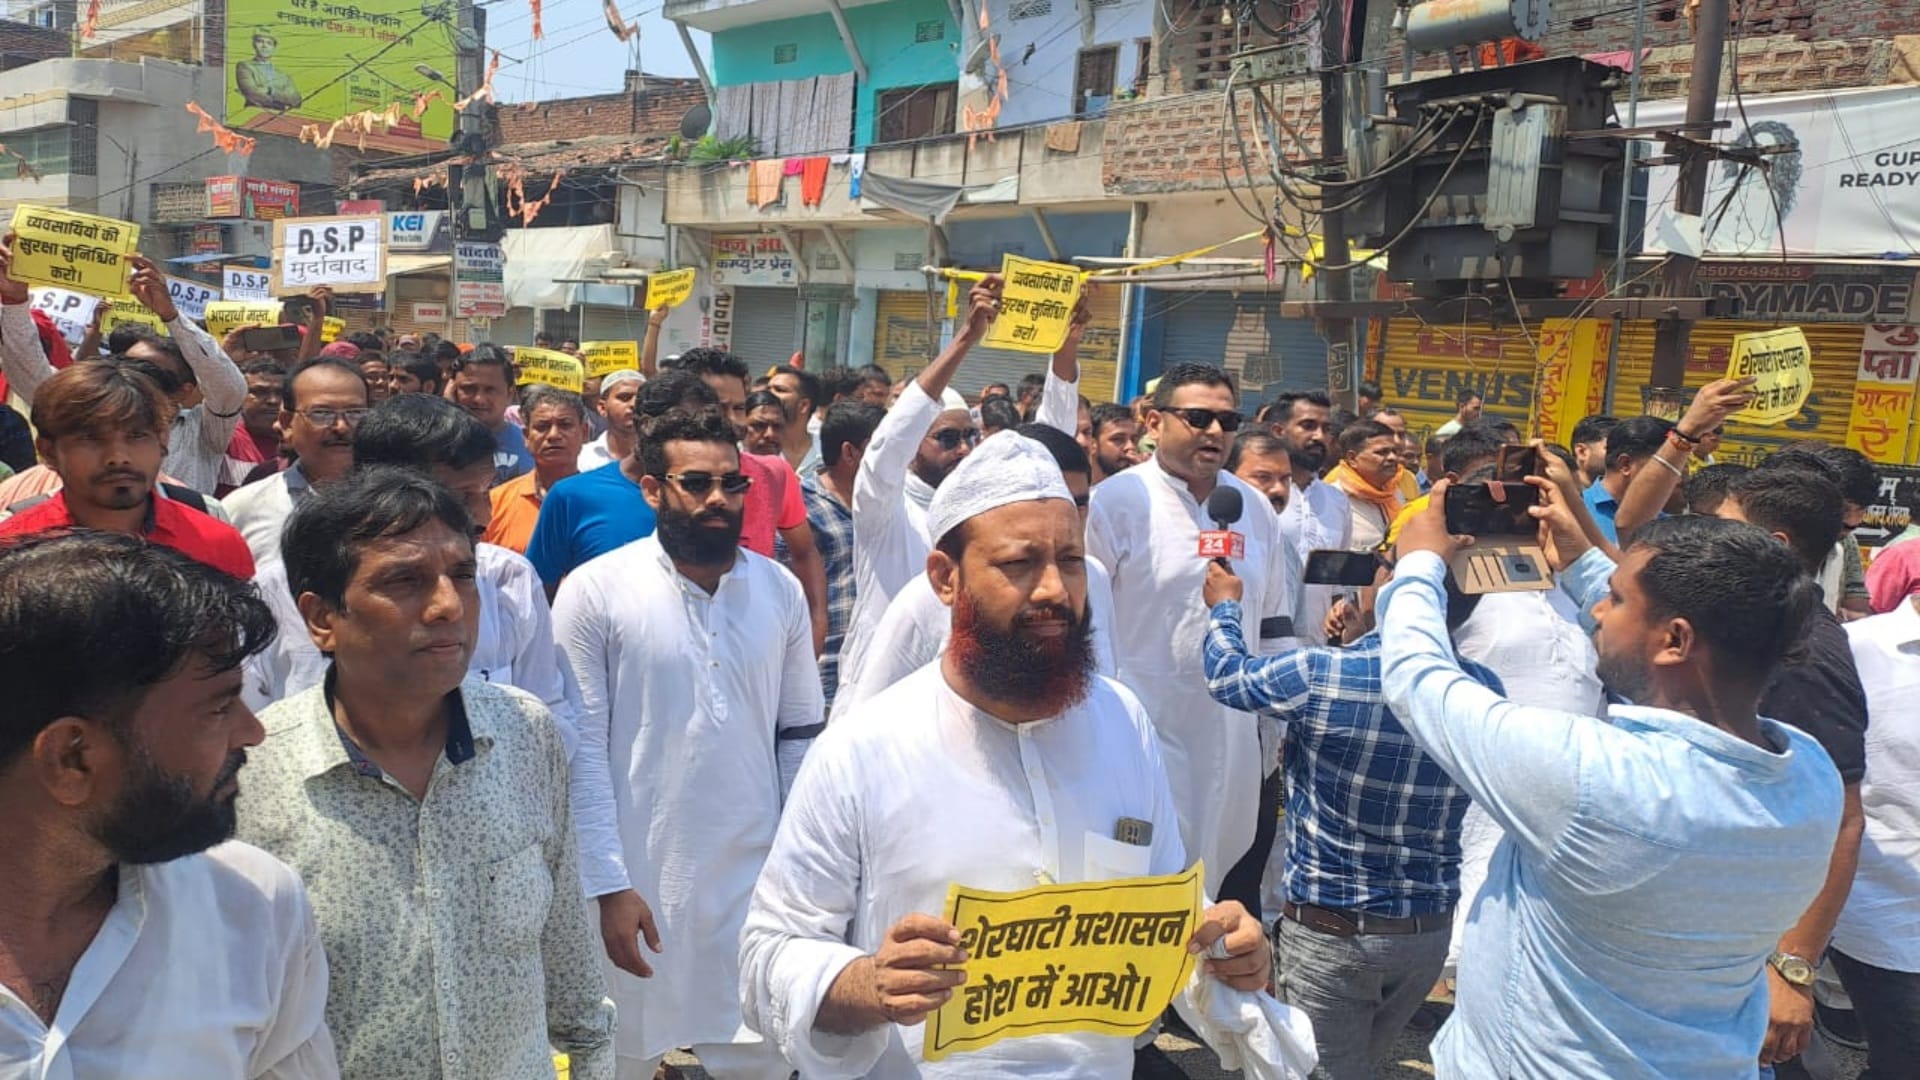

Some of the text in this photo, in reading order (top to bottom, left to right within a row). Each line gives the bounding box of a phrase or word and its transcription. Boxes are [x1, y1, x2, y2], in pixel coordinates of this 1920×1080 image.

[1839, 171, 1920, 188] READY
[393, 215, 425, 231] KEI
[101, 226, 120, 243] की
[298, 225, 364, 254] D.S.P
[231, 273, 269, 288] D.S.P
[171, 283, 210, 303] D.S.P
[1393, 368, 1534, 407] VENUS
[1203, 539, 1224, 549] 24
[960, 905, 1191, 960] शेरघाटी प्रशासन
[964, 962, 1152, 1025] होश में आओ।
